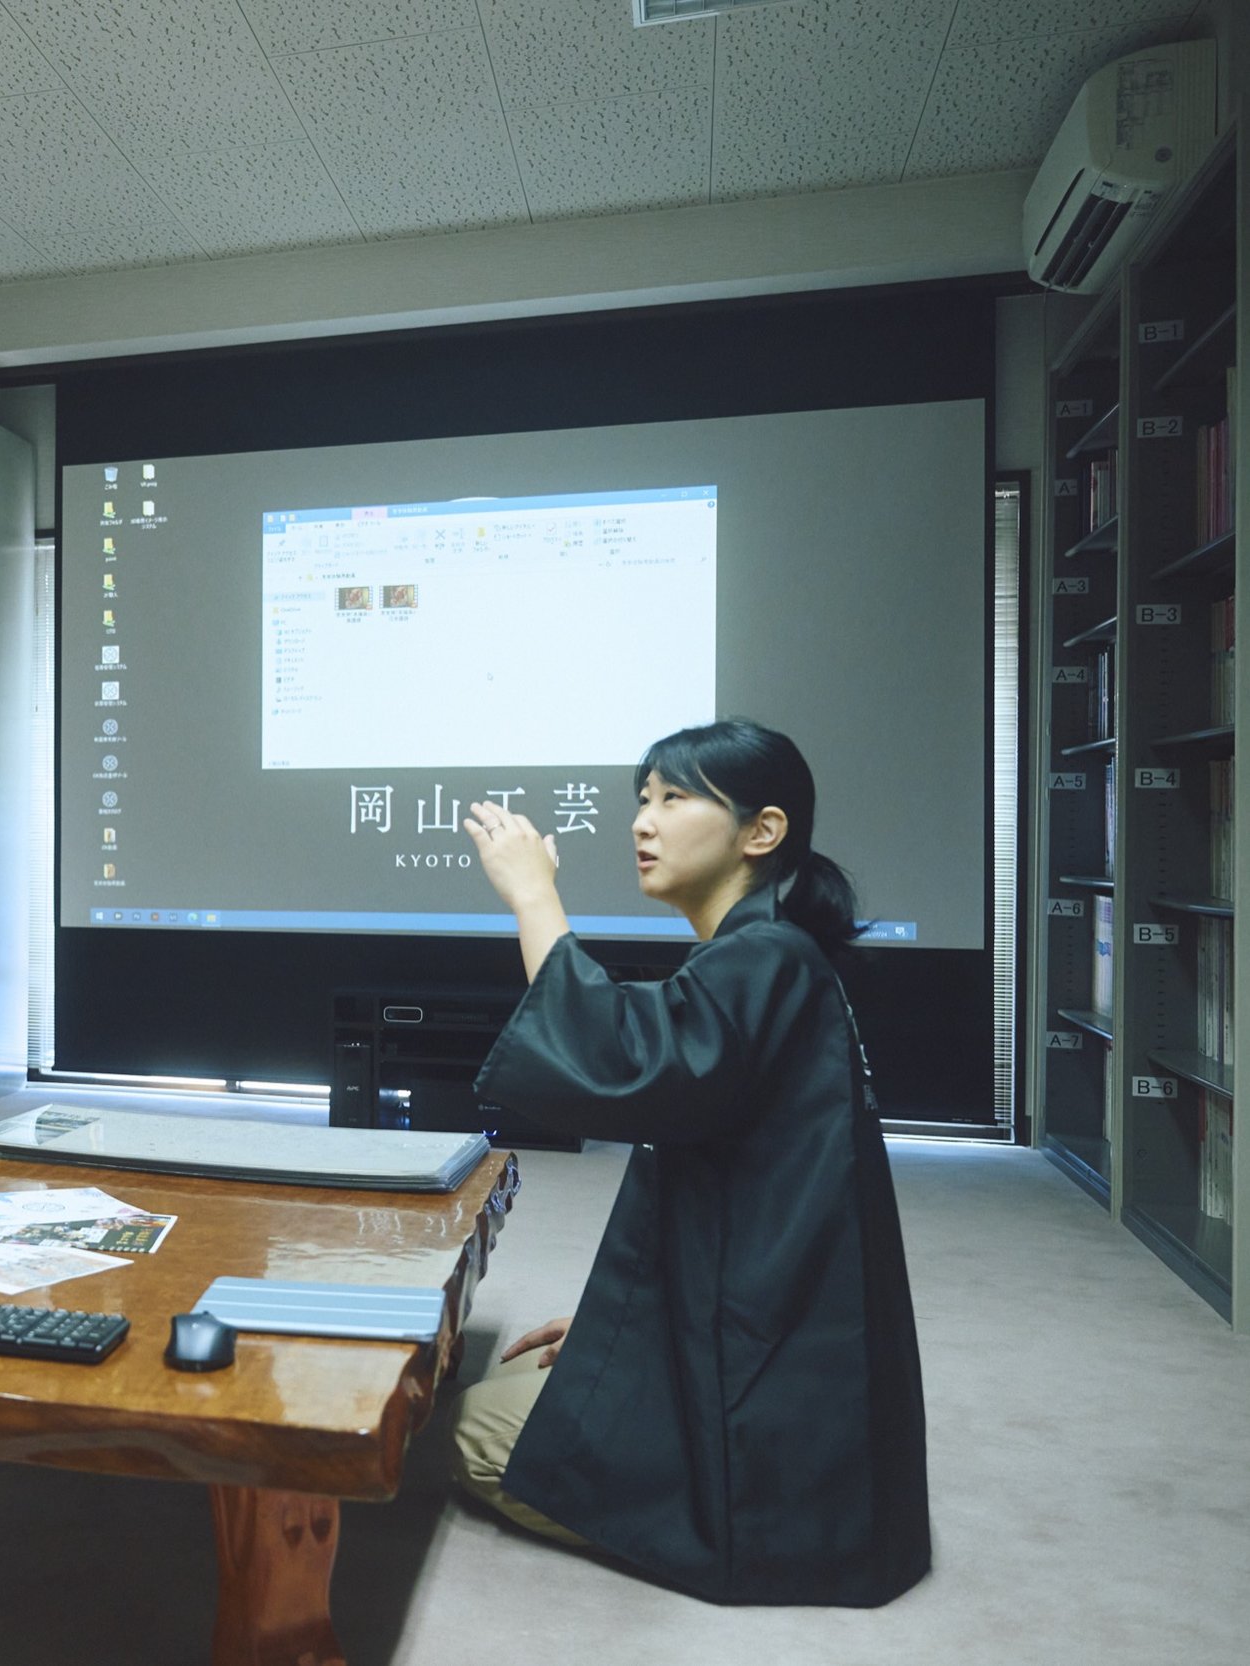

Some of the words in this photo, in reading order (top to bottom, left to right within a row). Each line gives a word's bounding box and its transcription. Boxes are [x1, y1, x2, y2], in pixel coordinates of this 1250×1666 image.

[1144, 325, 1178, 340] B-1
[1060, 403, 1087, 415] A-1
[1142, 420, 1178, 435] B-2
[1057, 580, 1086, 593] A-3
[1141, 607, 1178, 622] B-3
[1056, 669, 1086, 681] A-4
[1053, 775, 1083, 788] A-5
[1140, 771, 1176, 787] B-4
[395, 854, 471, 868] KYOTO
[1052, 902, 1081, 915] A-6
[1139, 926, 1175, 942] B-5
[1051, 1034, 1079, 1047] A-7
[1138, 1080, 1174, 1096] B-6
